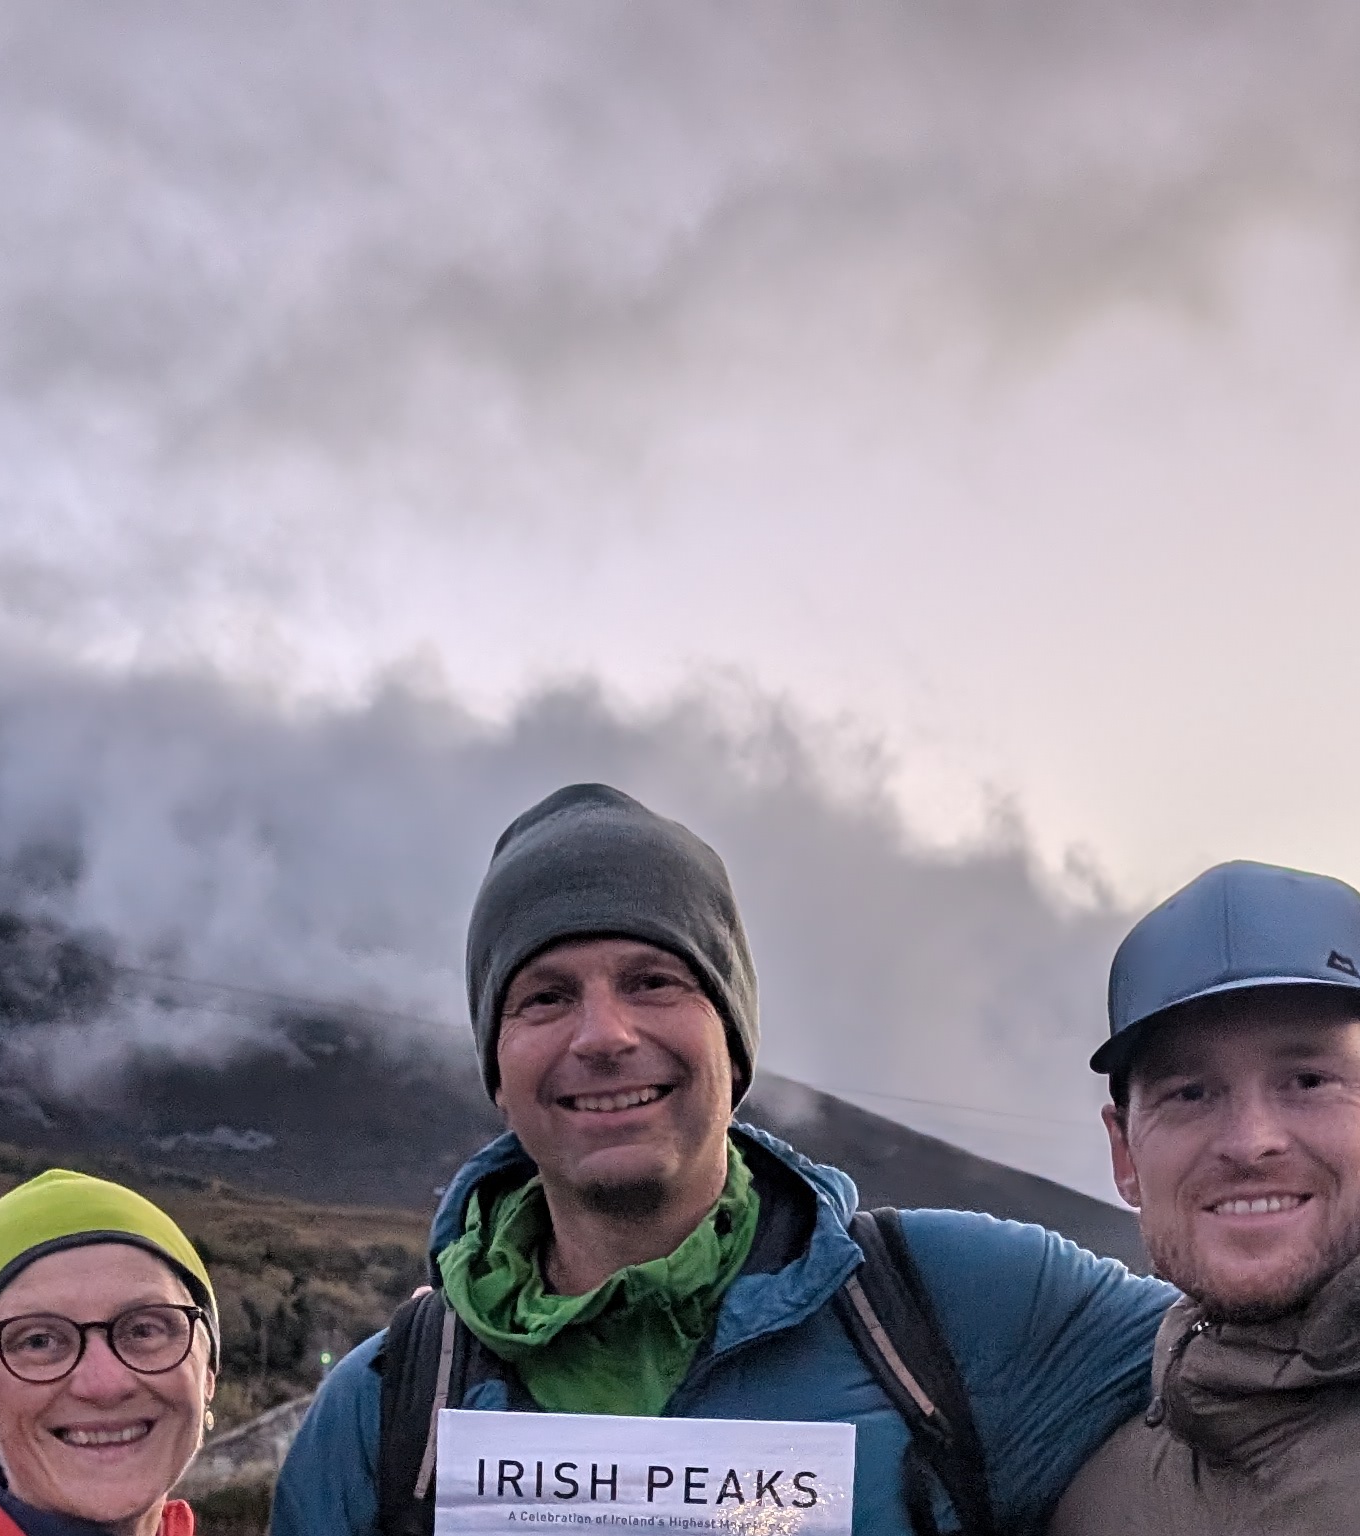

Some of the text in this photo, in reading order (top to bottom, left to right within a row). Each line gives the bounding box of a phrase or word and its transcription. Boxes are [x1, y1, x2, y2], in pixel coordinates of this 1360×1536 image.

[477, 1458, 818, 1509] IRISH PEAKS
[508, 1510, 784, 1534] A Celebration of Ireland's Highest Mountins
